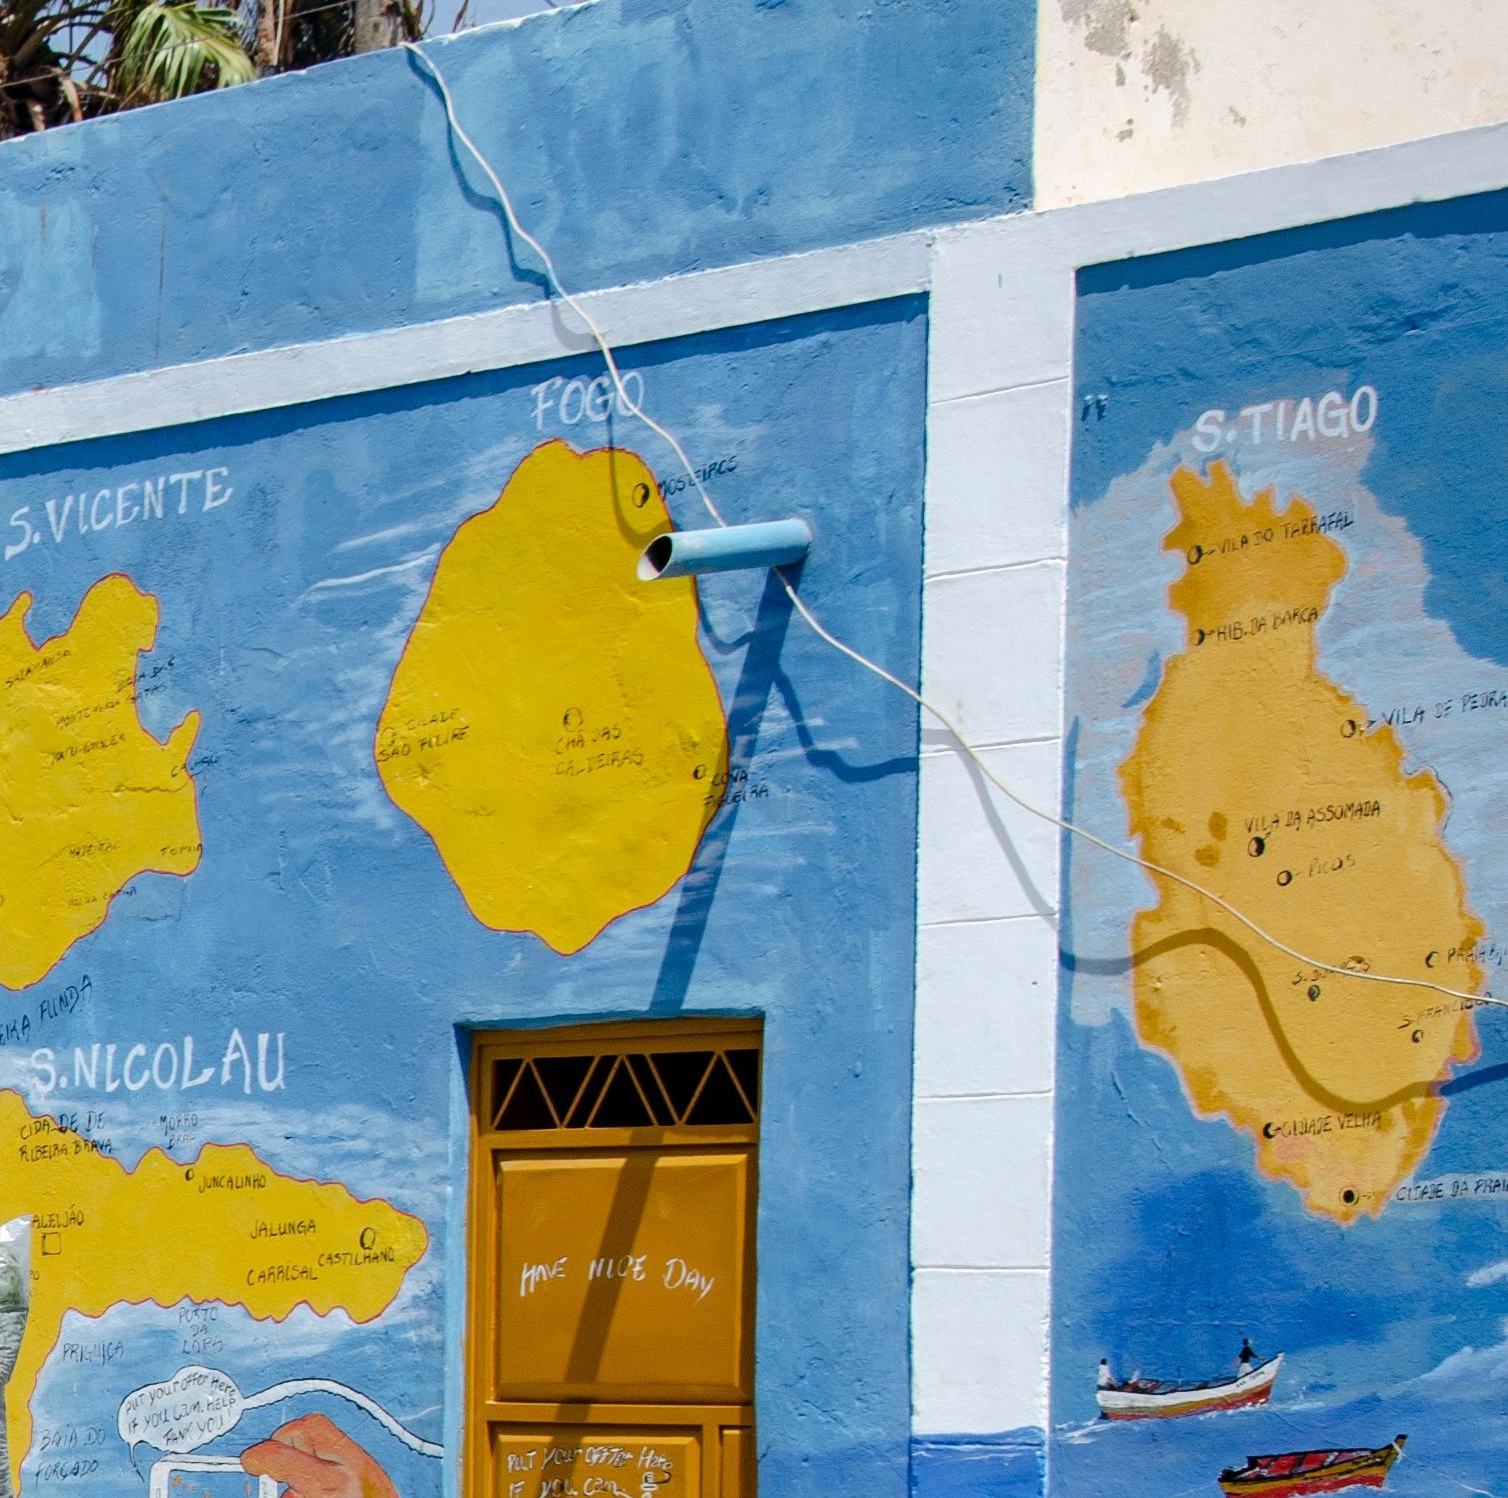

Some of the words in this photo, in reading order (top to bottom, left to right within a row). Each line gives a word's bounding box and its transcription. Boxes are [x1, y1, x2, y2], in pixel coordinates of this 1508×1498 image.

[530, 371, 645, 431] FOGO
[1190, 385, 1379, 453] S.TIAGO
[4, 466, 236, 561] S.VICENTE
[30, 1028, 286, 1097] S.NICOLAU
[1337, 1110, 1382, 1130] VELHA
[250, 1219, 316, 1239] JALUNGA
